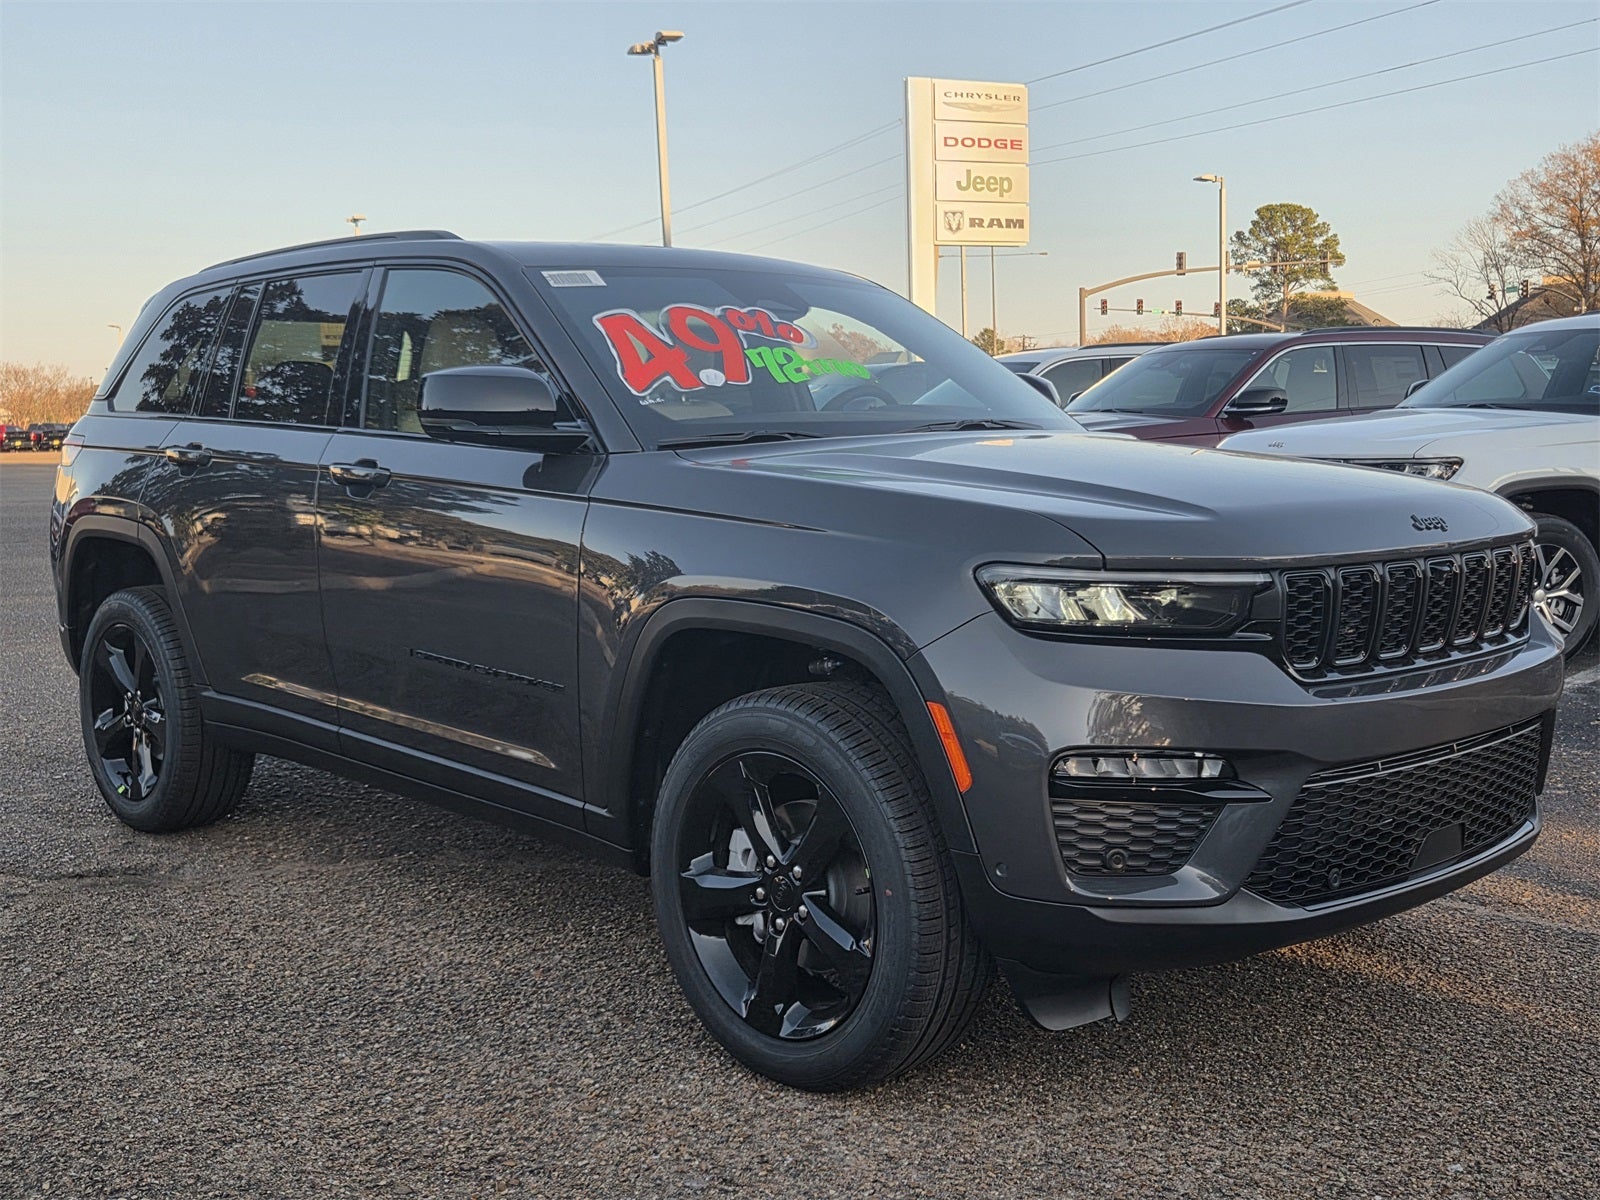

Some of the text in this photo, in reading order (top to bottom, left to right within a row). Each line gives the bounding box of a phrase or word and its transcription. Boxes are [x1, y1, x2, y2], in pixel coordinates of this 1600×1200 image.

[944, 91, 1021, 102] CHRYSLER
[943, 136, 1023, 150] DODGE
[956, 169, 1013, 197] Jeep
[968, 217, 1025, 229] RAM
[1410, 514, 1448, 532] Jeep
